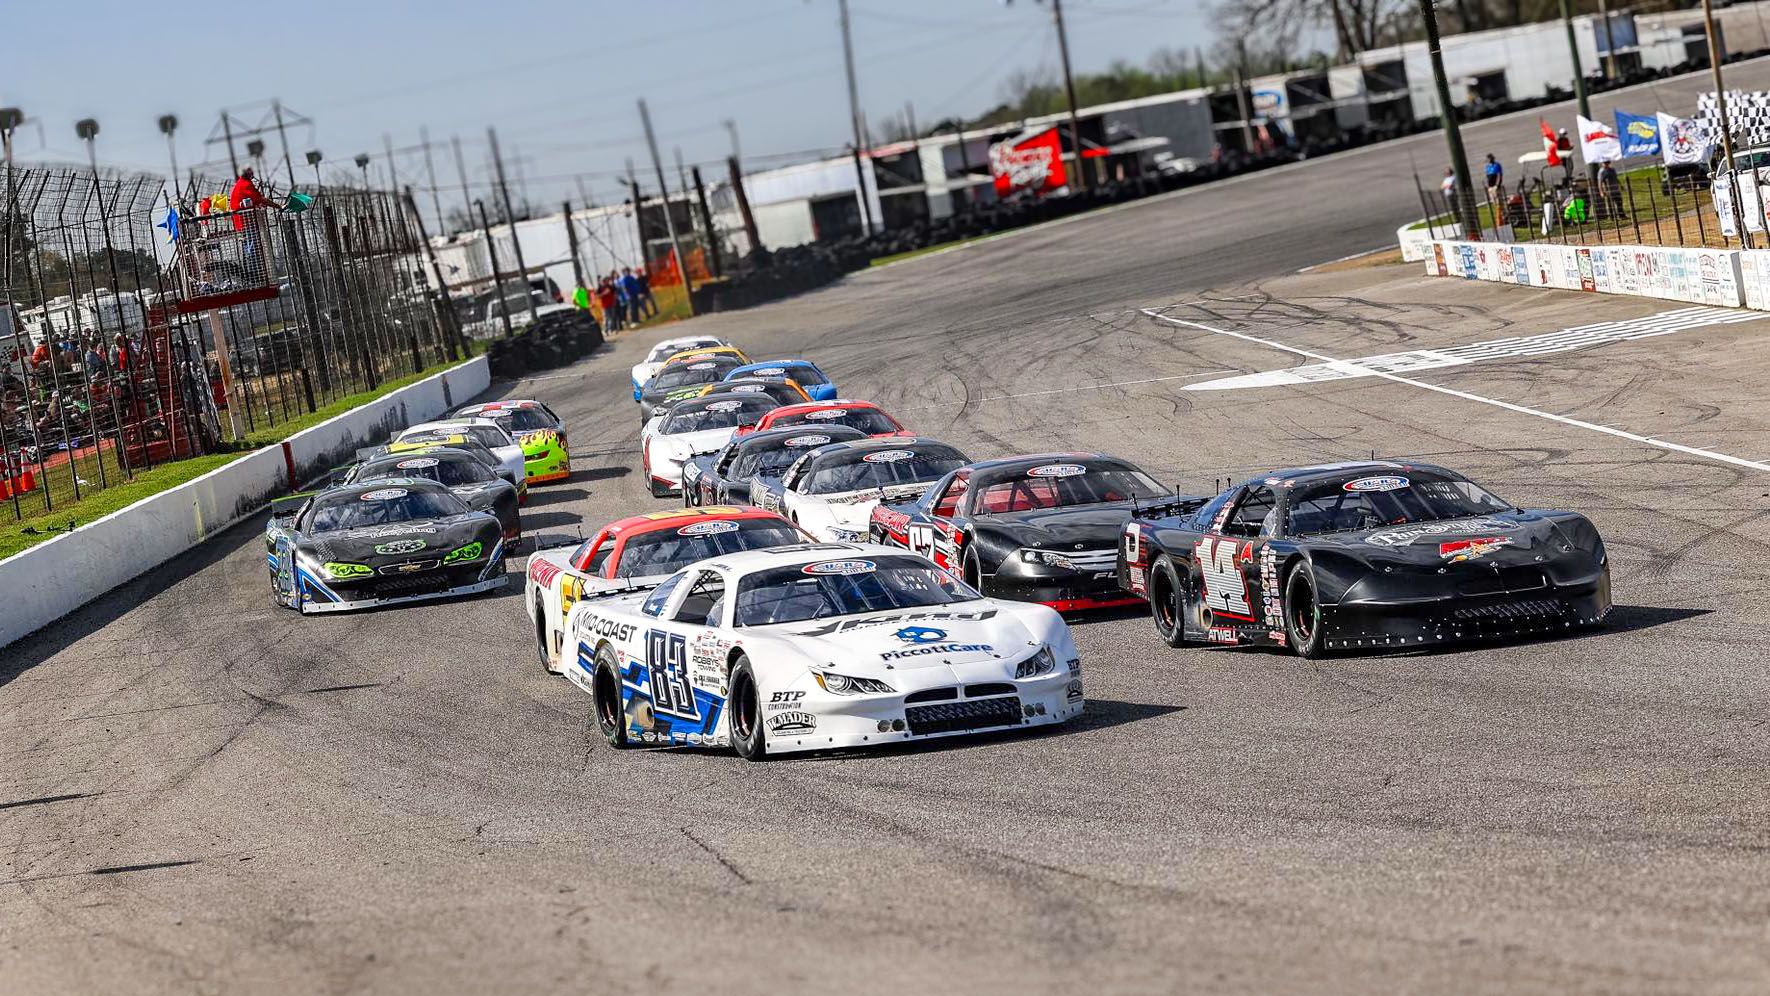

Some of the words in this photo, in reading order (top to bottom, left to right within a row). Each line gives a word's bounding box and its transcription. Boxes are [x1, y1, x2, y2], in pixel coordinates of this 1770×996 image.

[1208, 628, 1239, 641] ATWELL
[879, 642, 995, 662] PiccottCare
[645, 627, 702, 720] 83
[769, 690, 807, 703] BTP
